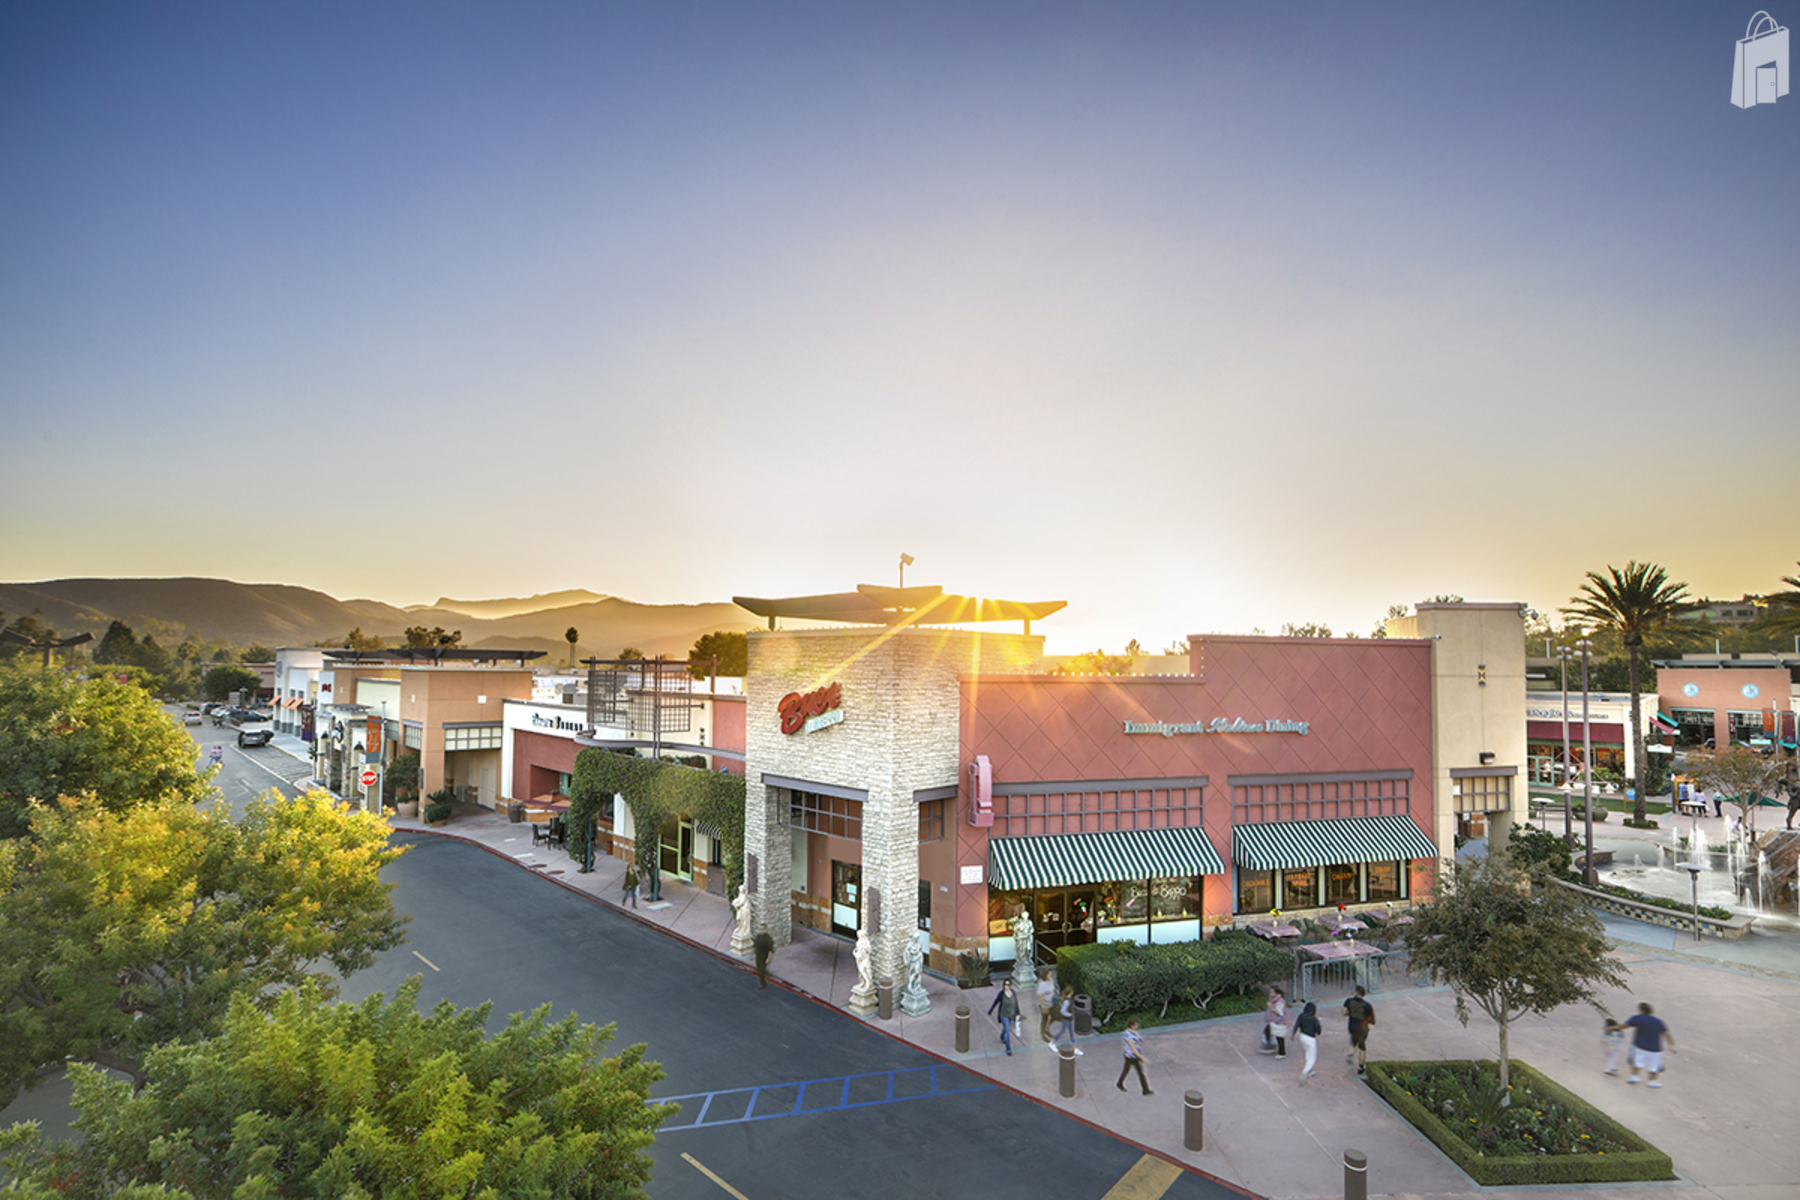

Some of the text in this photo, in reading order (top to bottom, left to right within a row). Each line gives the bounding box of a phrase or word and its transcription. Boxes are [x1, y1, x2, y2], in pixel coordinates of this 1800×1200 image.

[1124, 717, 1310, 737] Immigrant Italian Dining
